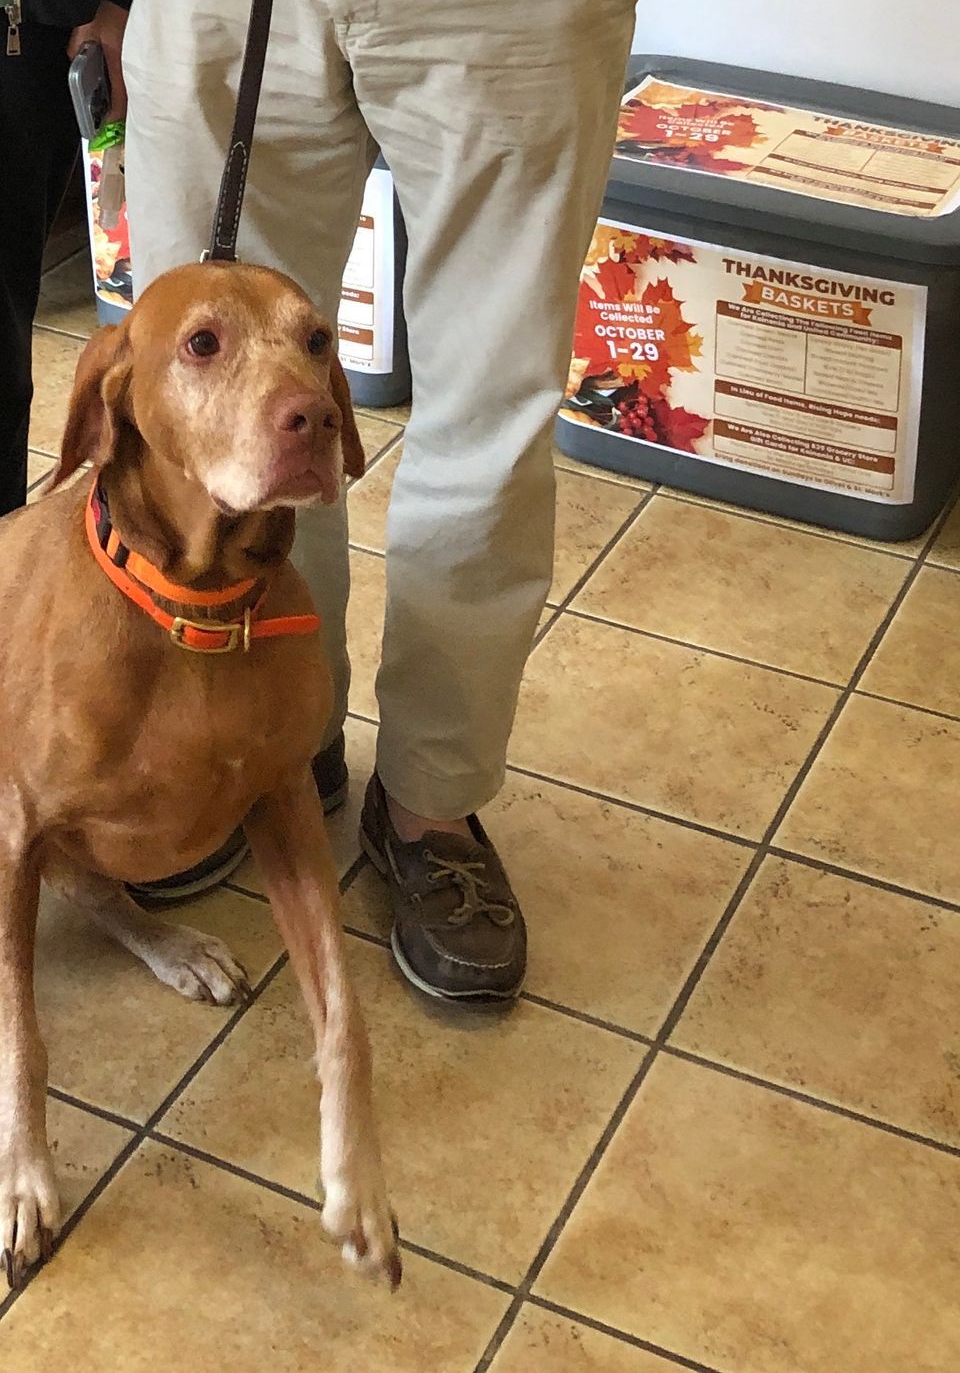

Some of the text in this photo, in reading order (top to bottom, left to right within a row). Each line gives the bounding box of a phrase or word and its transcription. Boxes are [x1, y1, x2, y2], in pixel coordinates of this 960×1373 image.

[655, 123, 732, 136] OCTOBER
[722, 258, 896, 306] THANKSGIVING
[589, 300, 660, 314] Items Will Be
[761, 286, 854, 316] BASKETS
[727, 302, 740, 311] We
[741, 306, 755, 314] Are
[600, 311, 653, 324] Collected
[594, 324, 665, 341] OCTOBER
[764, 394, 783, 403] Food
[727, 423, 740, 431] We
[740, 427, 754, 435] Are
[754, 430, 771, 439] Also
[764, 439, 787, 450] Cards
